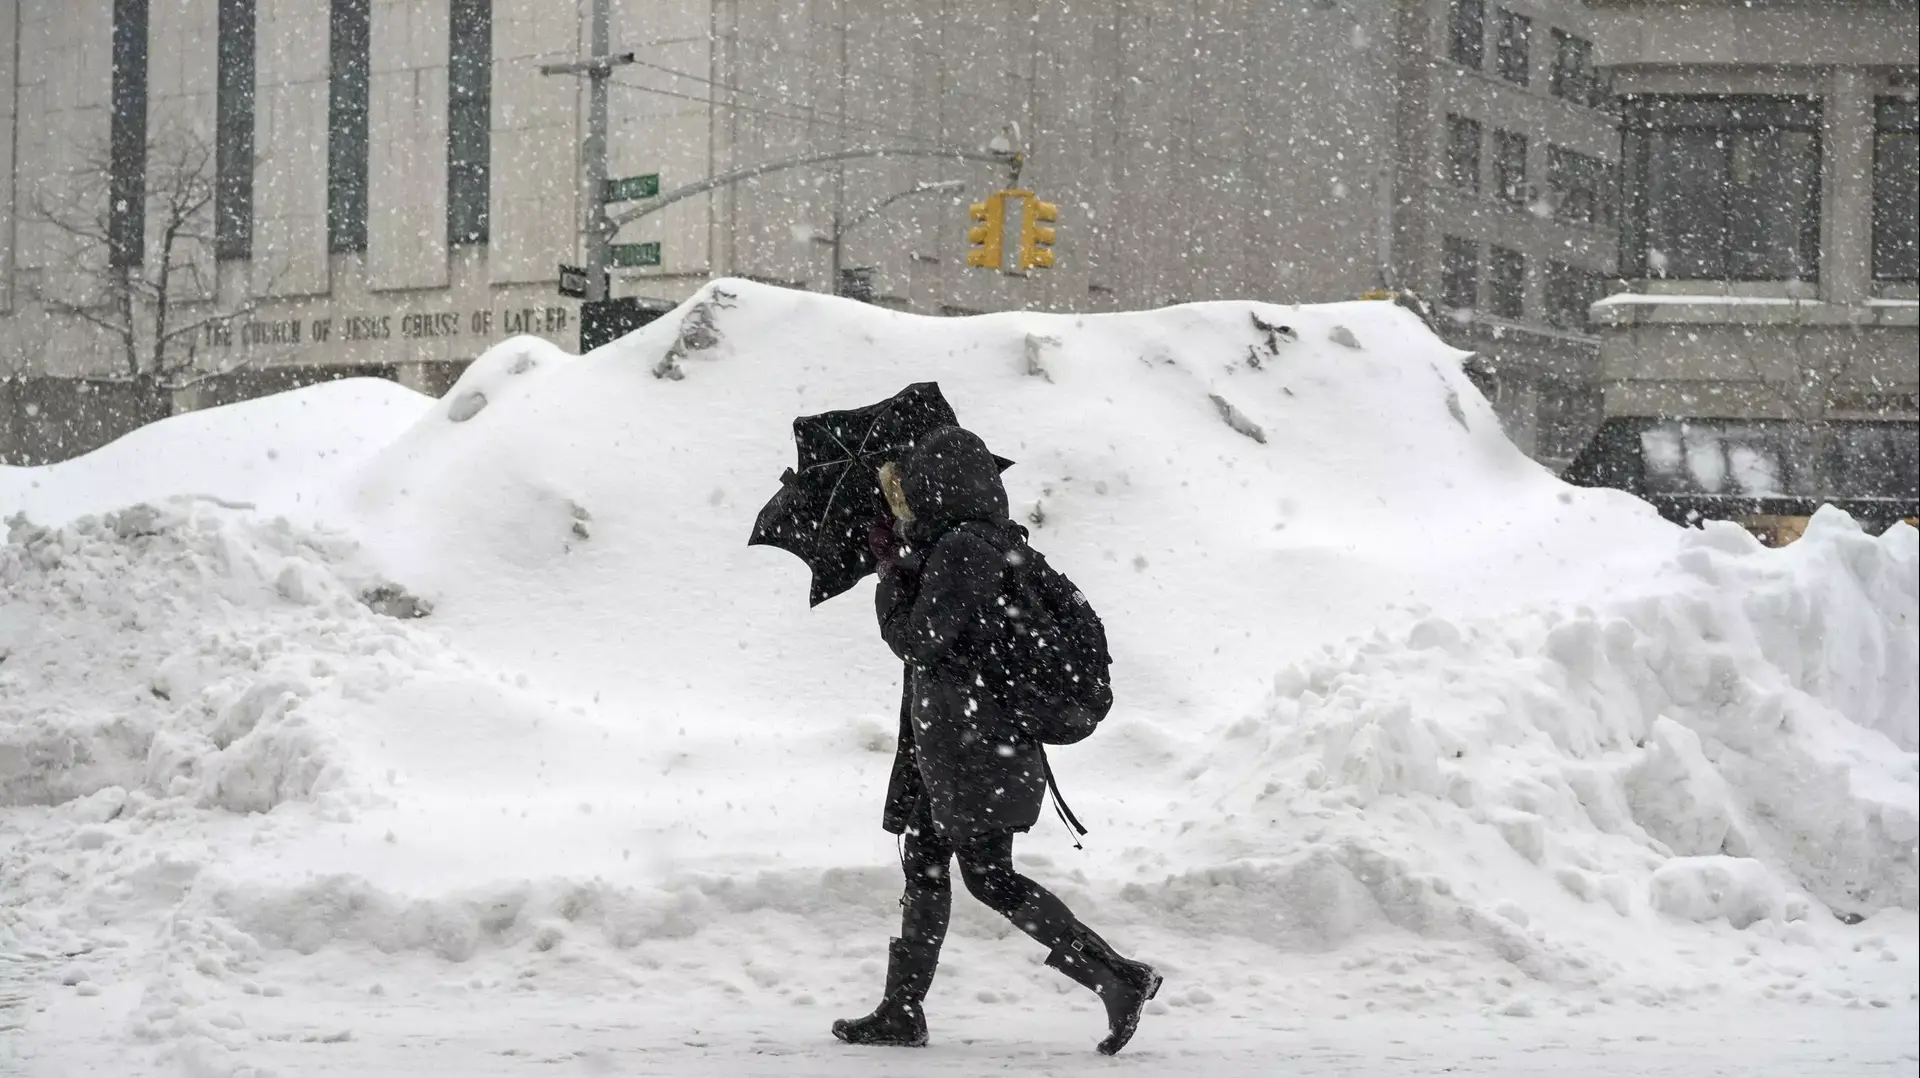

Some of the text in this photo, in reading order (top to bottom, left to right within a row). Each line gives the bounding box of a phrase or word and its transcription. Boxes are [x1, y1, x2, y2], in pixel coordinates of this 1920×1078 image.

[312, 318, 332, 342] OF
[344, 315, 390, 341] JESUS
[471, 310, 492, 334] OF
